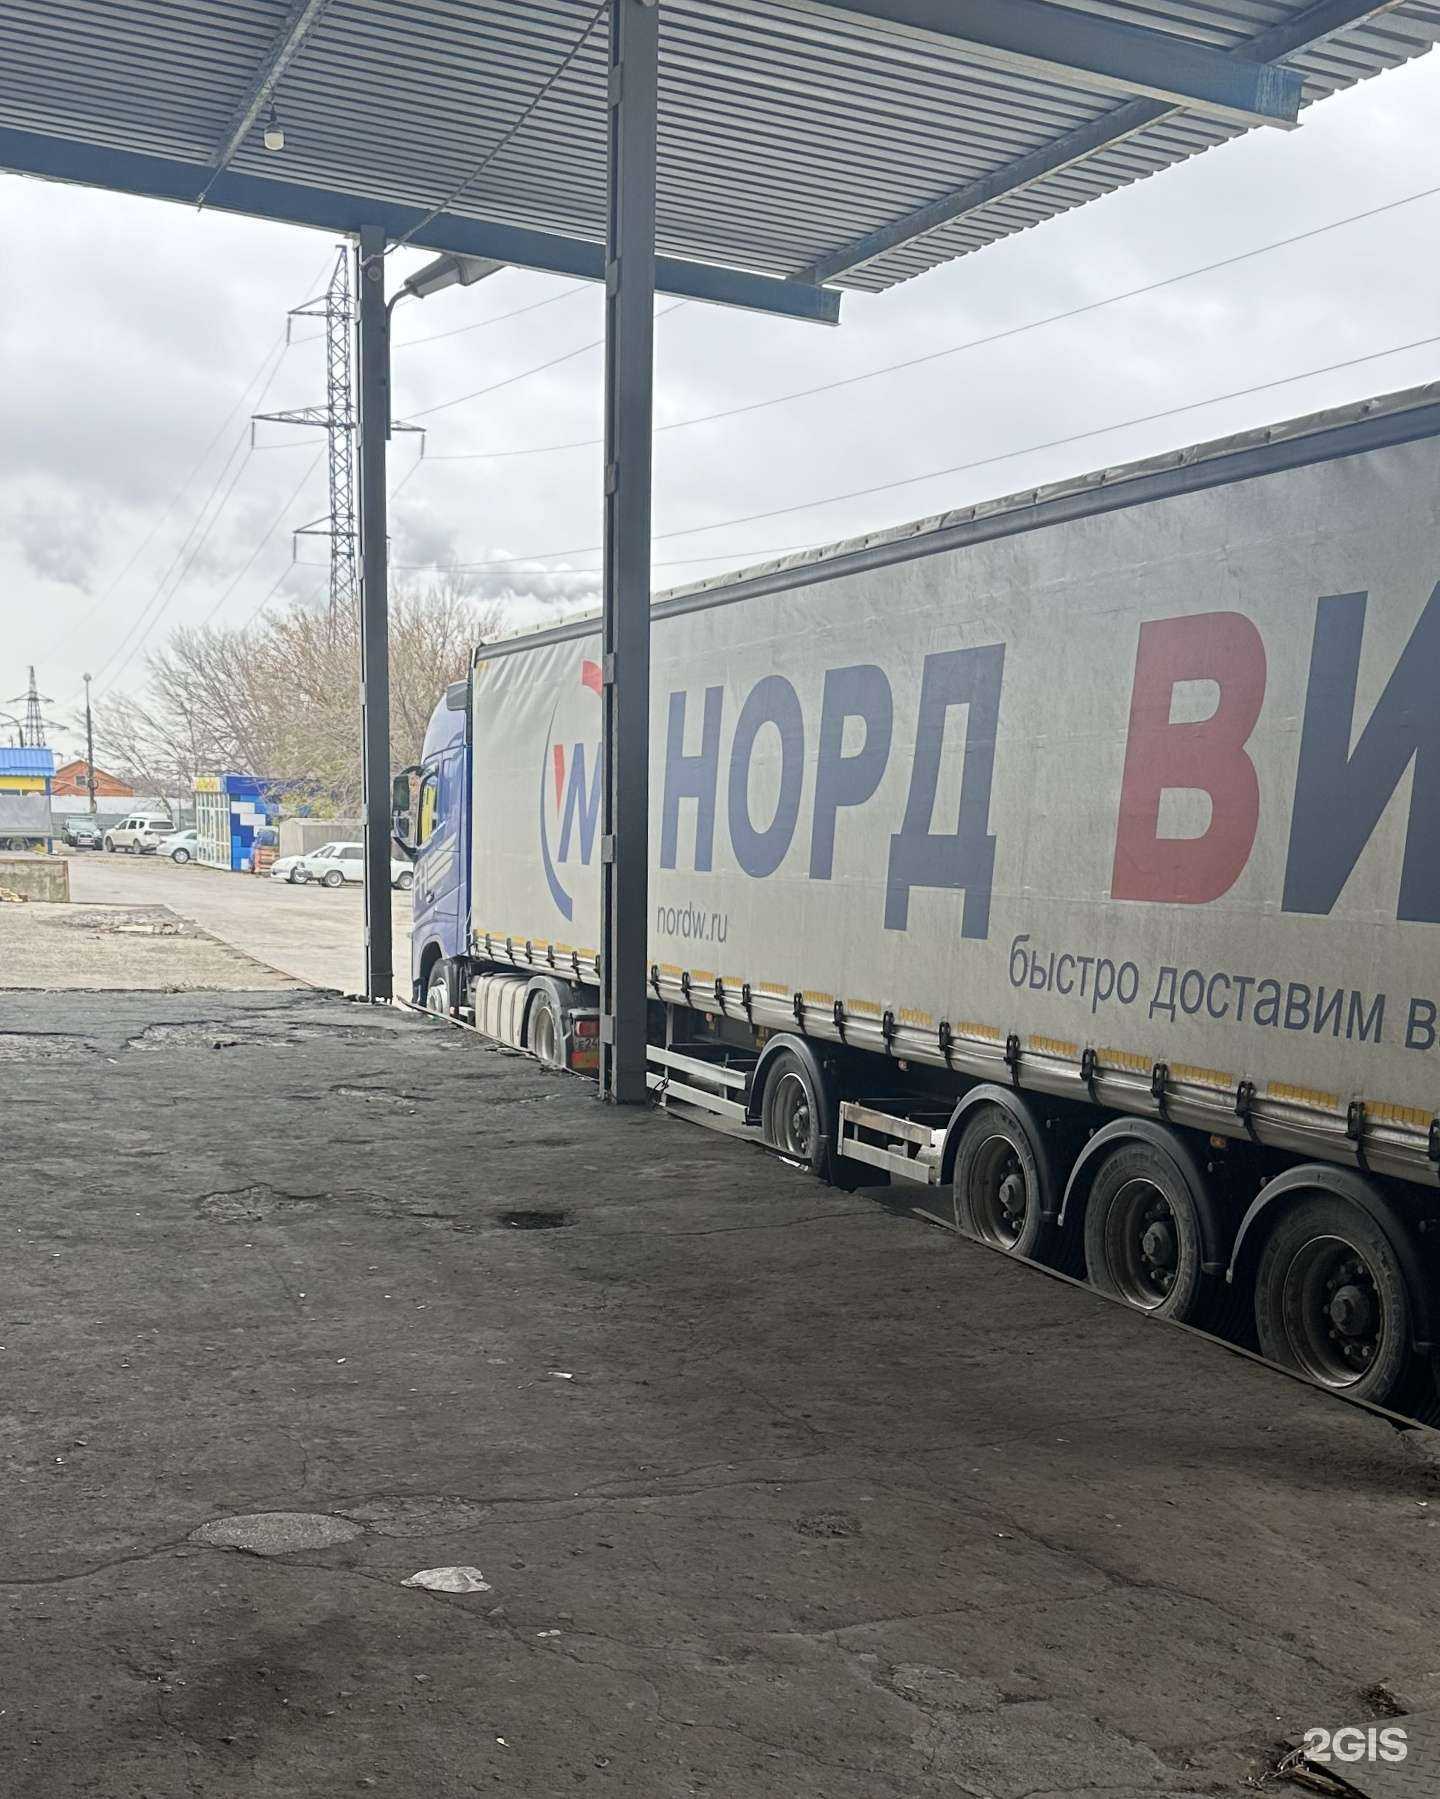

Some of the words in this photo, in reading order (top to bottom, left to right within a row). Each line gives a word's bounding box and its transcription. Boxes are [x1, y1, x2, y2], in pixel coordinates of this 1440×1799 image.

[660, 643, 1005, 940] НОРД
[656, 901, 728, 943] nordw.ru
[1009, 934, 1139, 1012] быстро
[1149, 965, 1386, 1043] доставим
[1404, 998, 1440, 1050] в
